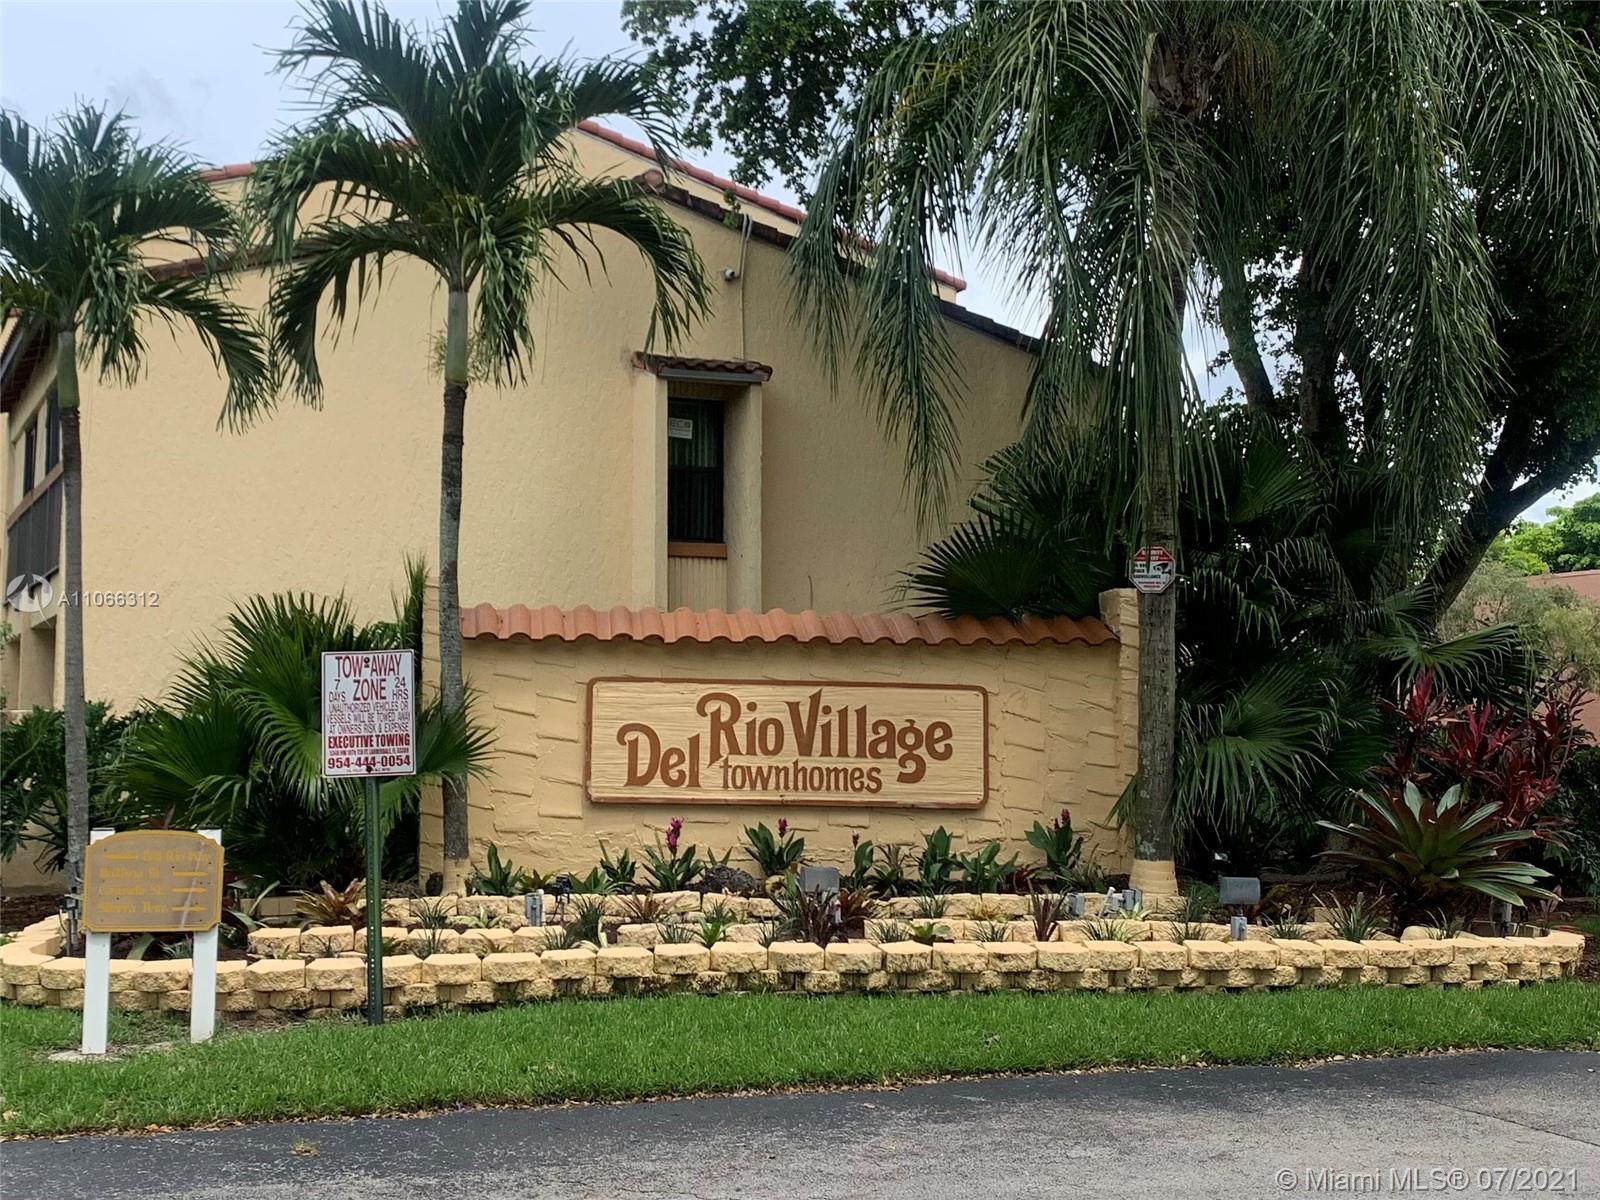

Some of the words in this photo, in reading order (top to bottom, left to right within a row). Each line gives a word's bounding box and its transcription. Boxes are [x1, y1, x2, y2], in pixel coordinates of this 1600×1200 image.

[334, 678, 340, 690] 7
[394, 676, 406, 689] 24
[353, 678, 386, 701] ZONE
[392, 688, 409, 700] HRS
[329, 691, 346, 702] DAYS
[329, 702, 371, 713] UNAUTHORIZED
[372, 701, 398, 712] VEHICLES
[400, 701, 409, 710] OR
[327, 713, 352, 724] VESSELS
[353, 712, 366, 723] WILL
[367, 712, 375, 723] BE
[376, 712, 396, 722] TOWED
[397, 711, 410, 721] AWAY
[329, 724, 336, 734] AT
[338, 723, 362, 734] OWNERS
[363, 723, 376, 733] RISK
[384, 722, 409, 732] EXPENSE
[328, 735, 374, 749] EXECUTIVE
[375, 733, 411, 747] TOWING
[616, 722, 701, 788] Del
[696, 692, 784, 769] Rio
[785, 687, 953, 784] Village
[328, 755, 411, 769] 954-444-0054
[719, 756, 882, 794] townhomes
